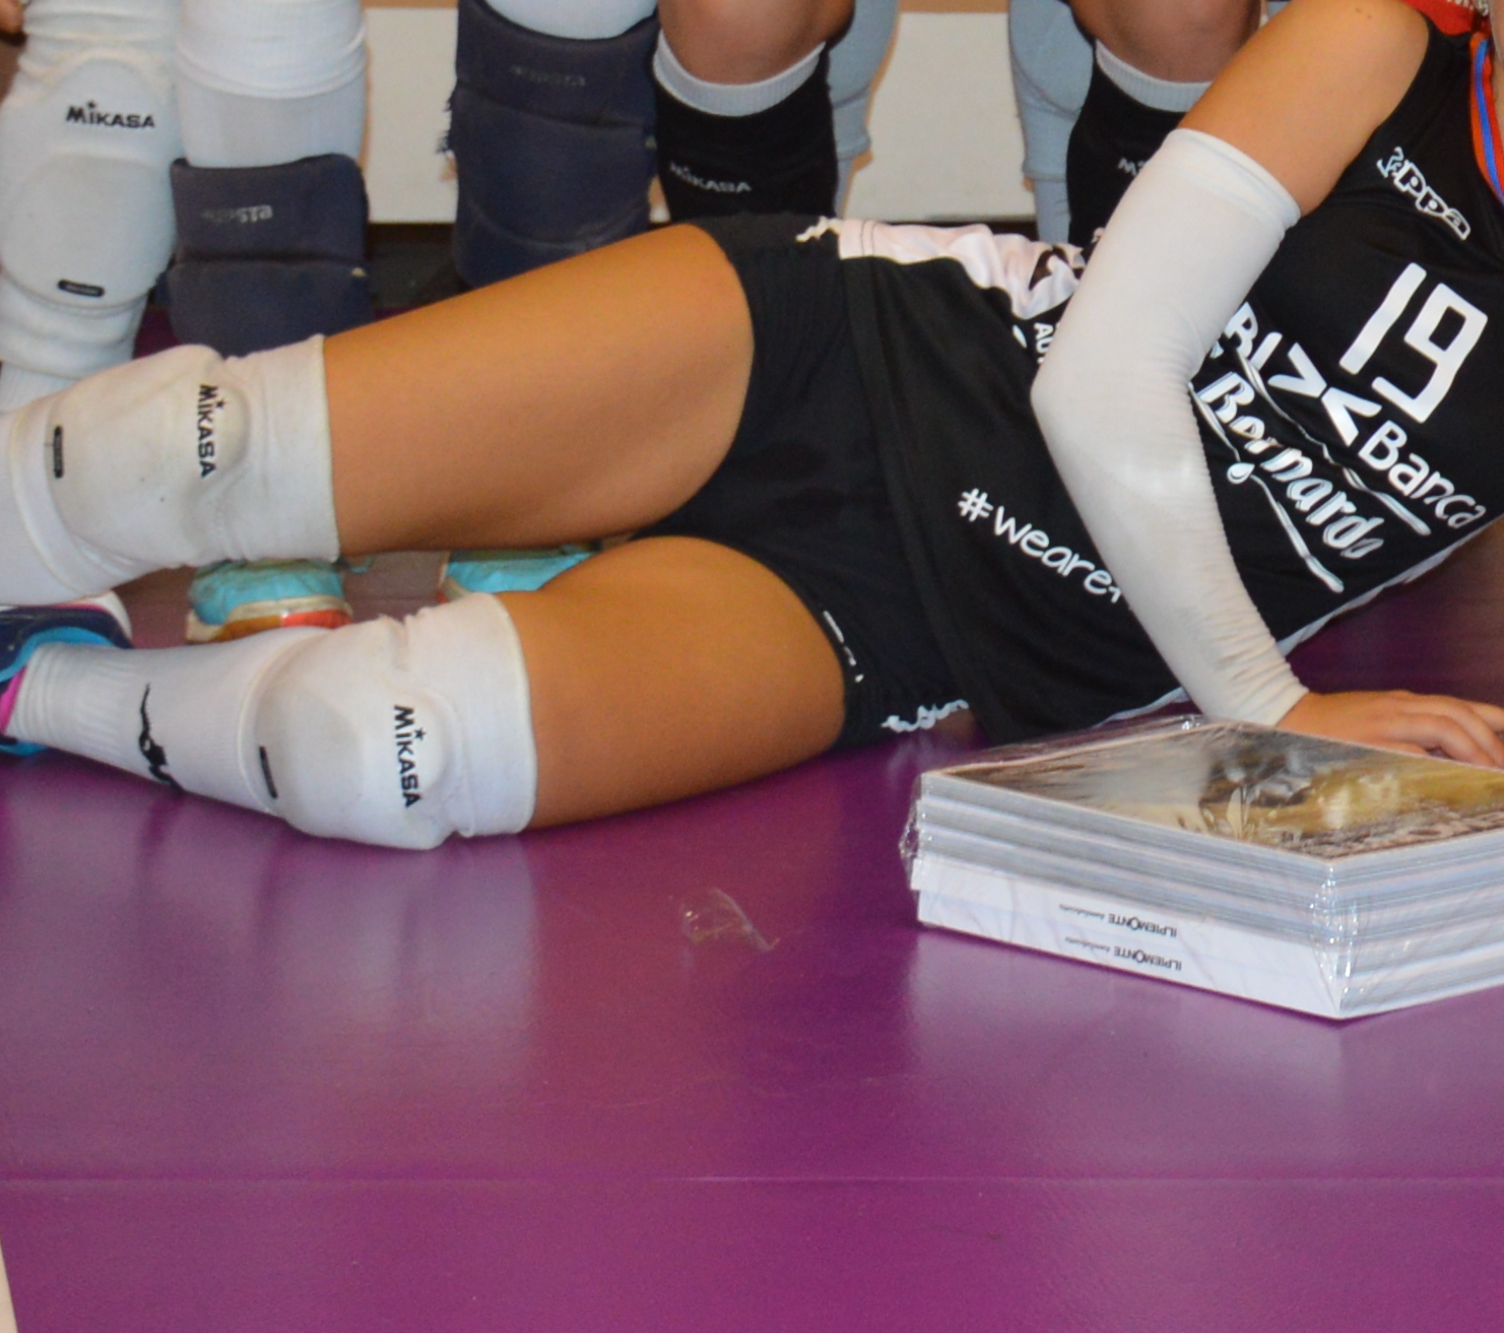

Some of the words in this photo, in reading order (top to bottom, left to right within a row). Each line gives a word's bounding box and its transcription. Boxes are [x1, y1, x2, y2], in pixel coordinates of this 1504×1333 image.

[65, 101, 156, 130] MIKASA
[1339, 262, 1489, 424] 19
[196, 383, 227, 479] MIKASA
[1198, 370, 1386, 560] Bernardo
[1358, 419, 1486, 532] Banca
[392, 703, 426, 809] MIKASA
